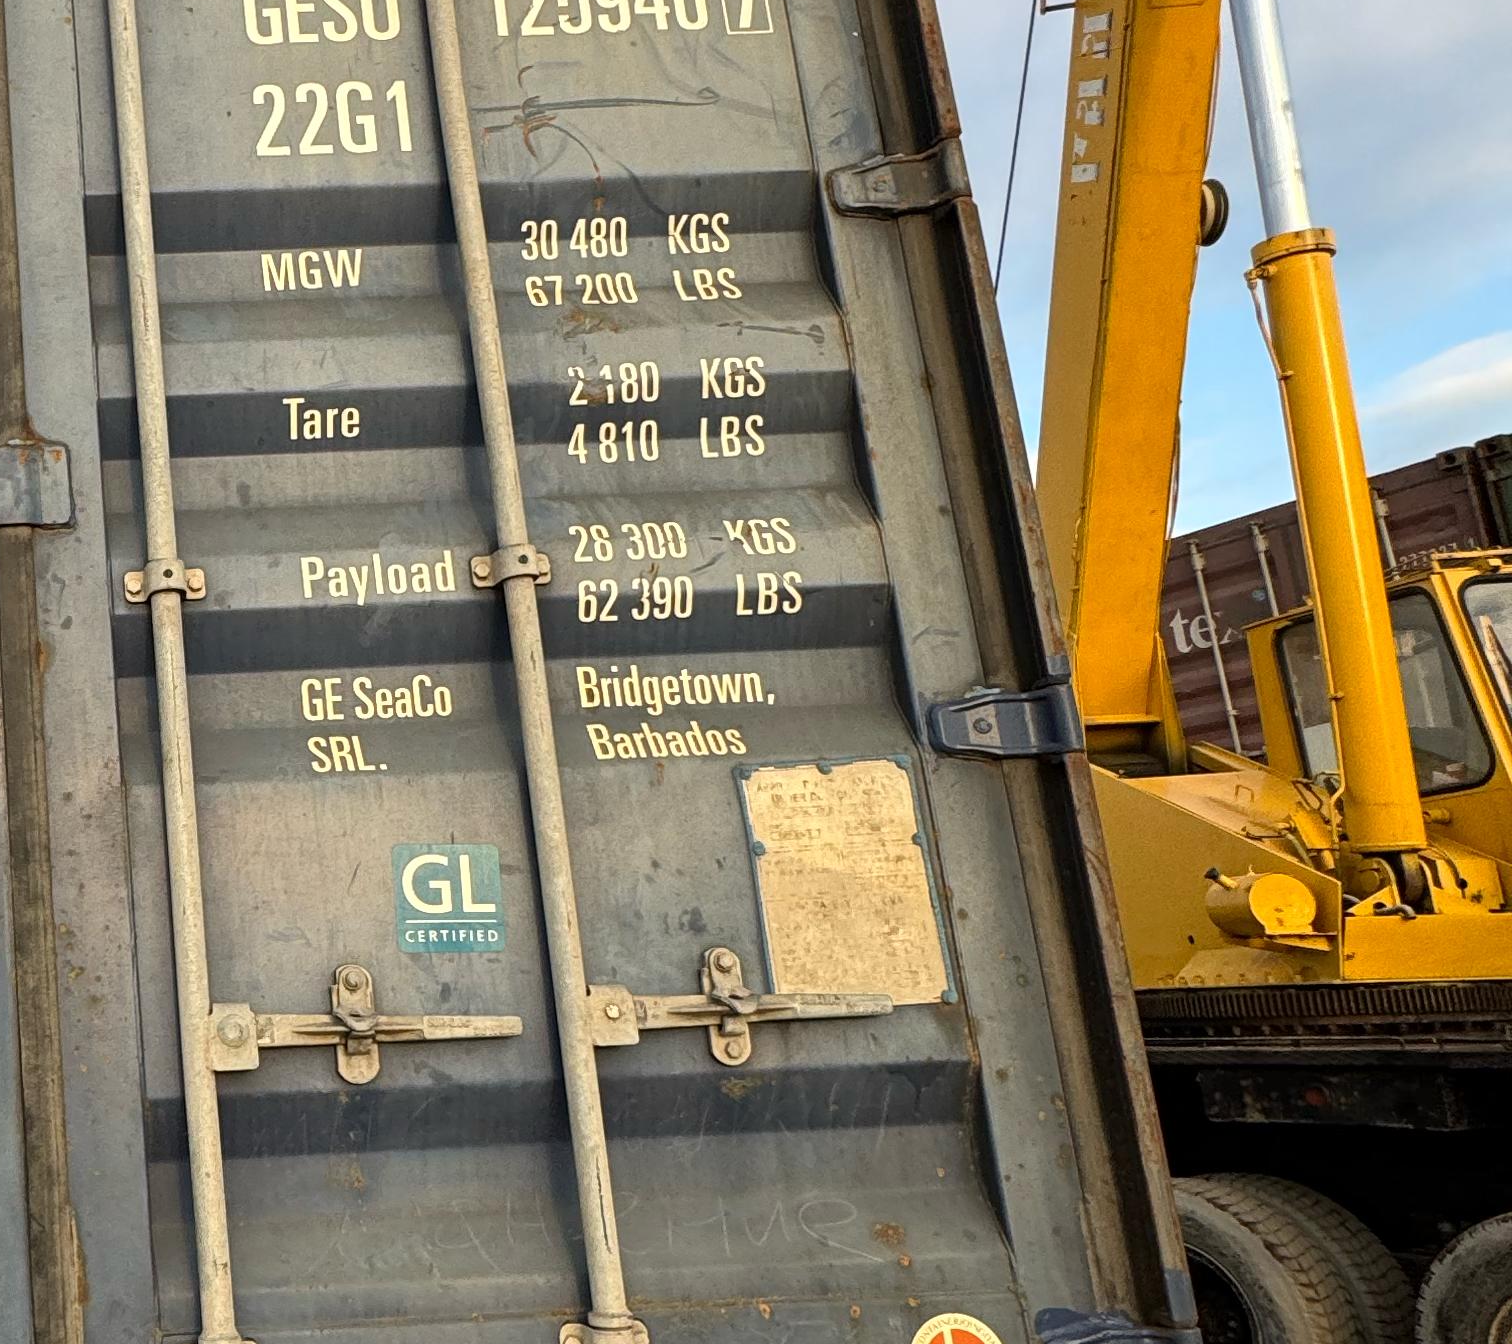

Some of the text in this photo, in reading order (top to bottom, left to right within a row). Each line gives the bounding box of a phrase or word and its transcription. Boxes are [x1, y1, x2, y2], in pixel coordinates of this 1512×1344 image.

[252, 80, 413, 157] 22G1
[260, 212, 730, 292] MGW 30 480 KGS
[525, 267, 742, 307] 67 200 LBS
[282, 397, 360, 440] Tare
[699, 356, 766, 399] KGS
[599, 420, 659, 464] 810
[700, 414, 765, 458] LBS
[300, 549, 456, 606] Payload
[624, 521, 688, 560] 300
[722, 517, 796, 555] KGS
[578, 571, 803, 623] 62 390 LBS
[301, 664, 775, 722] GE SeaCo Bridgetown,
[307, 720, 747, 773] SRL. Barbados
[401, 853, 497, 915] GL
[404, 929, 499, 943] CERTIFIED
